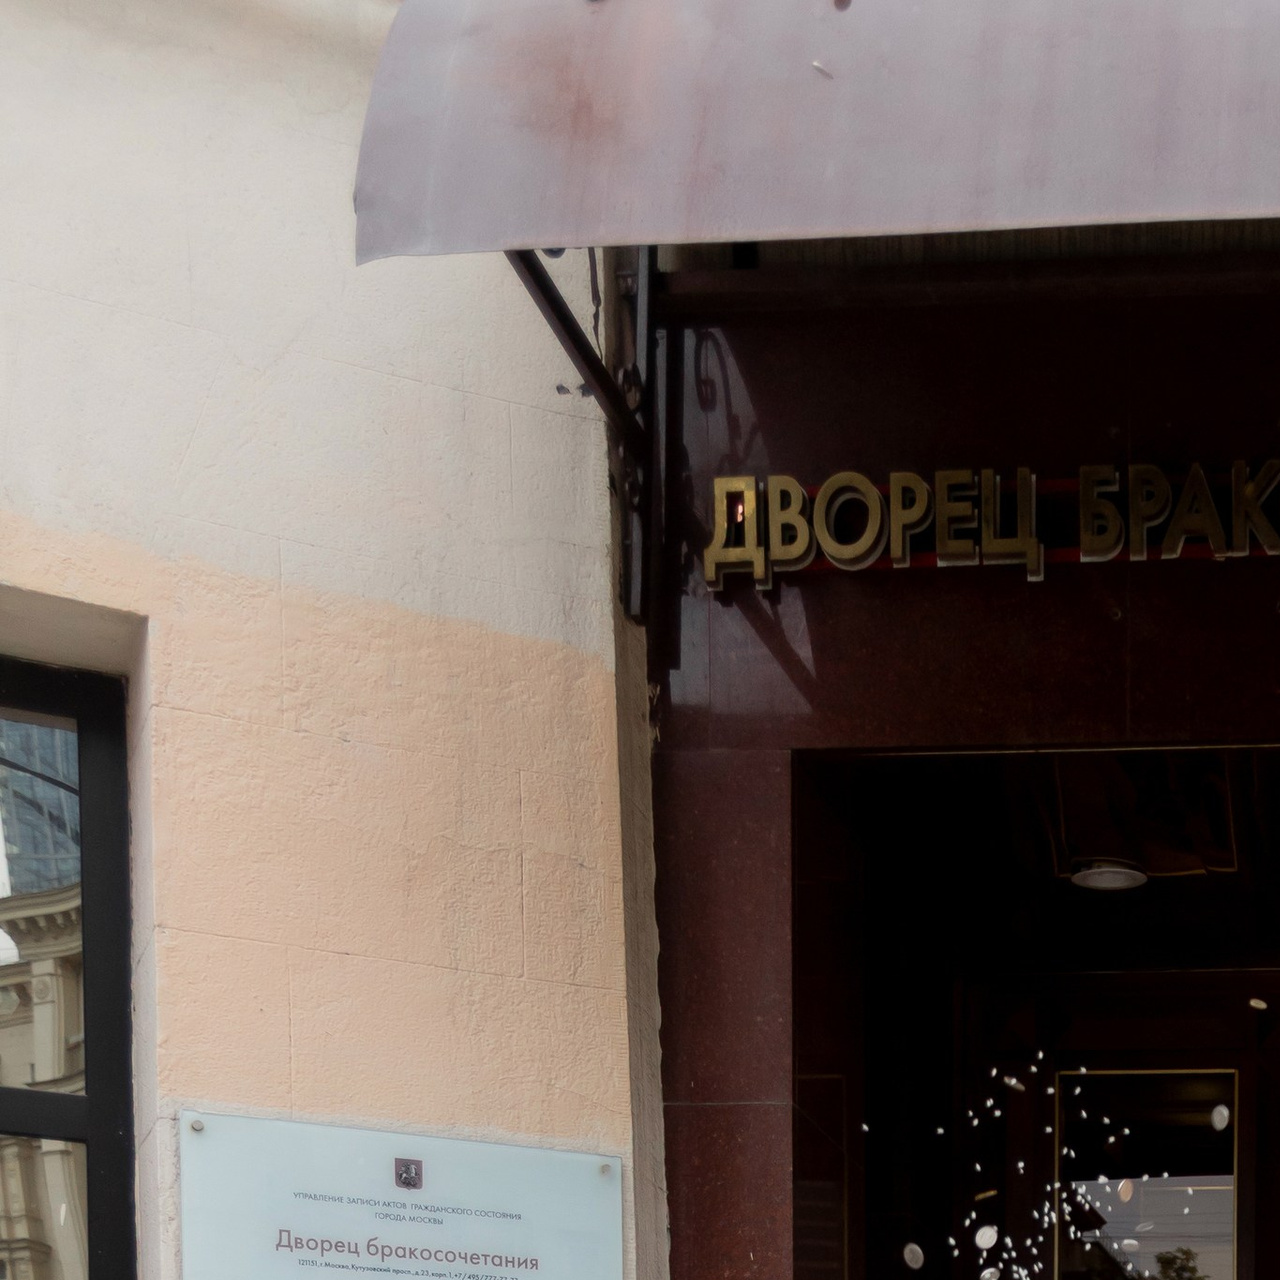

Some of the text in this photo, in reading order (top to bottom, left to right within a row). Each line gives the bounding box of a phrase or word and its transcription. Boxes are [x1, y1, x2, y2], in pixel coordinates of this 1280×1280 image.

[704, 470, 1044, 587] ДВОРЕЦ
[293, 1192, 522, 1221] УПРАВЛЕНИЕ ЗАПИСИ АКТОВ ГРАЖДАНСКОГО СОСТОЯНИЯ
[374, 1212, 444, 1226] ГОРОДА МОСКВЫ
[275, 1229, 540, 1271] Дворец бракосочетания
